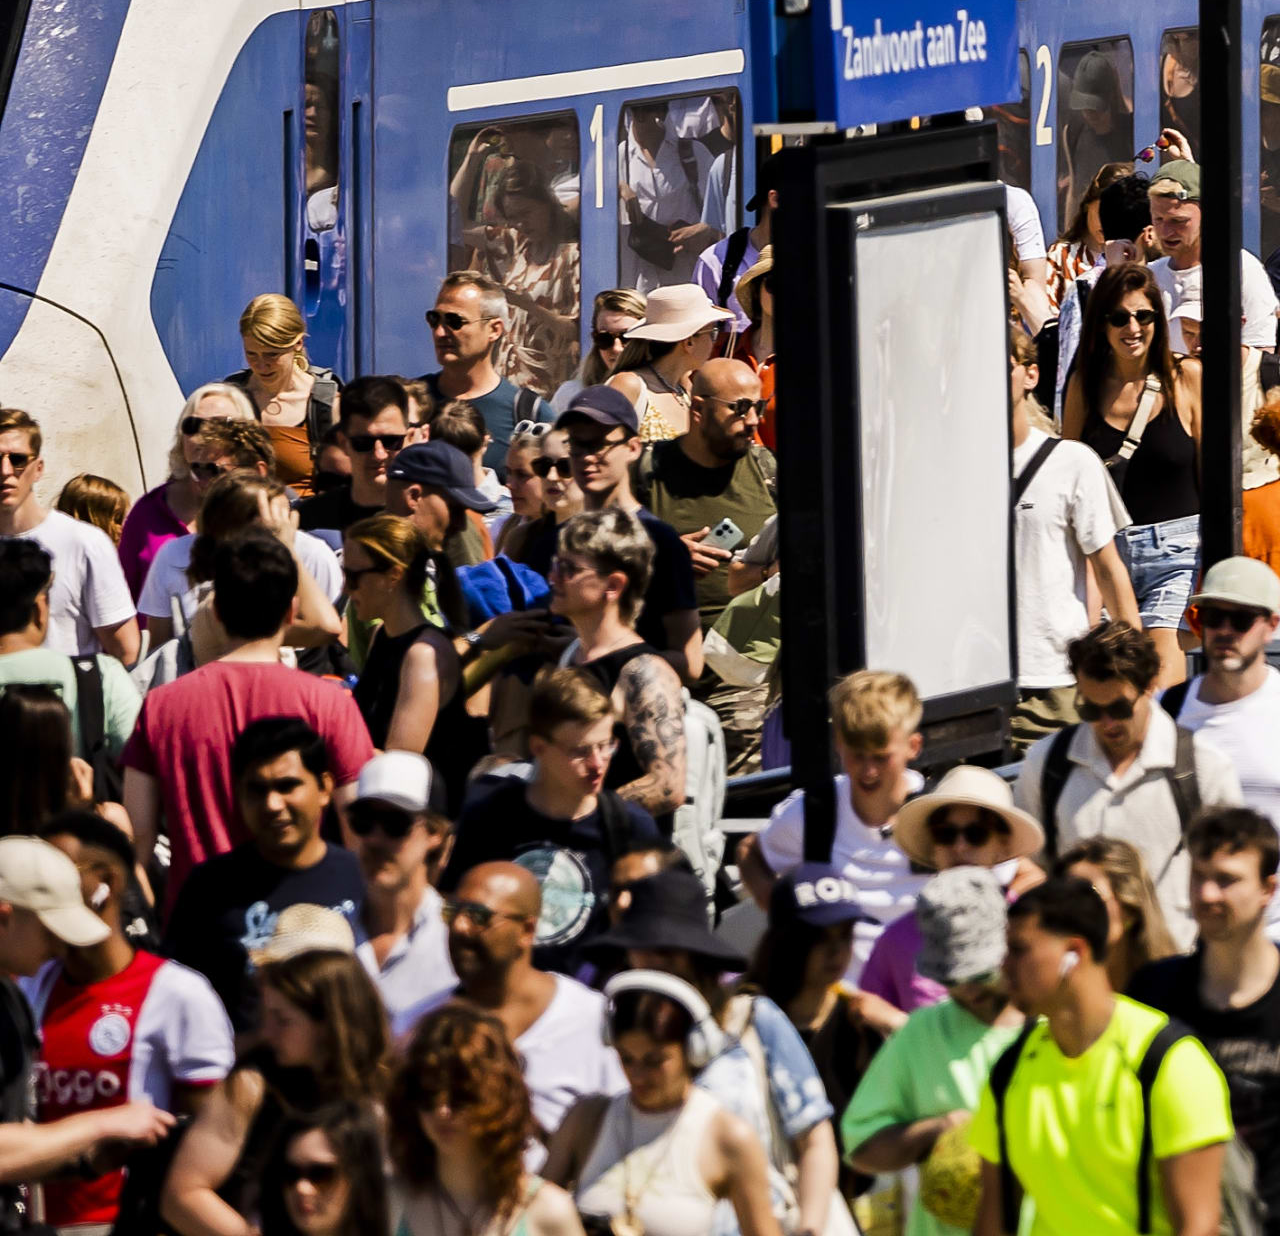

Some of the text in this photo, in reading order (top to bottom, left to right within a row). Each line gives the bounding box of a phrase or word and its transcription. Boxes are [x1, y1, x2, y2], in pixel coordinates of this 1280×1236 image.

[842, 9, 987, 80] Zandvoort aan Zee
[1036, 44, 1053, 146] 2
[589, 104, 604, 208] 1
